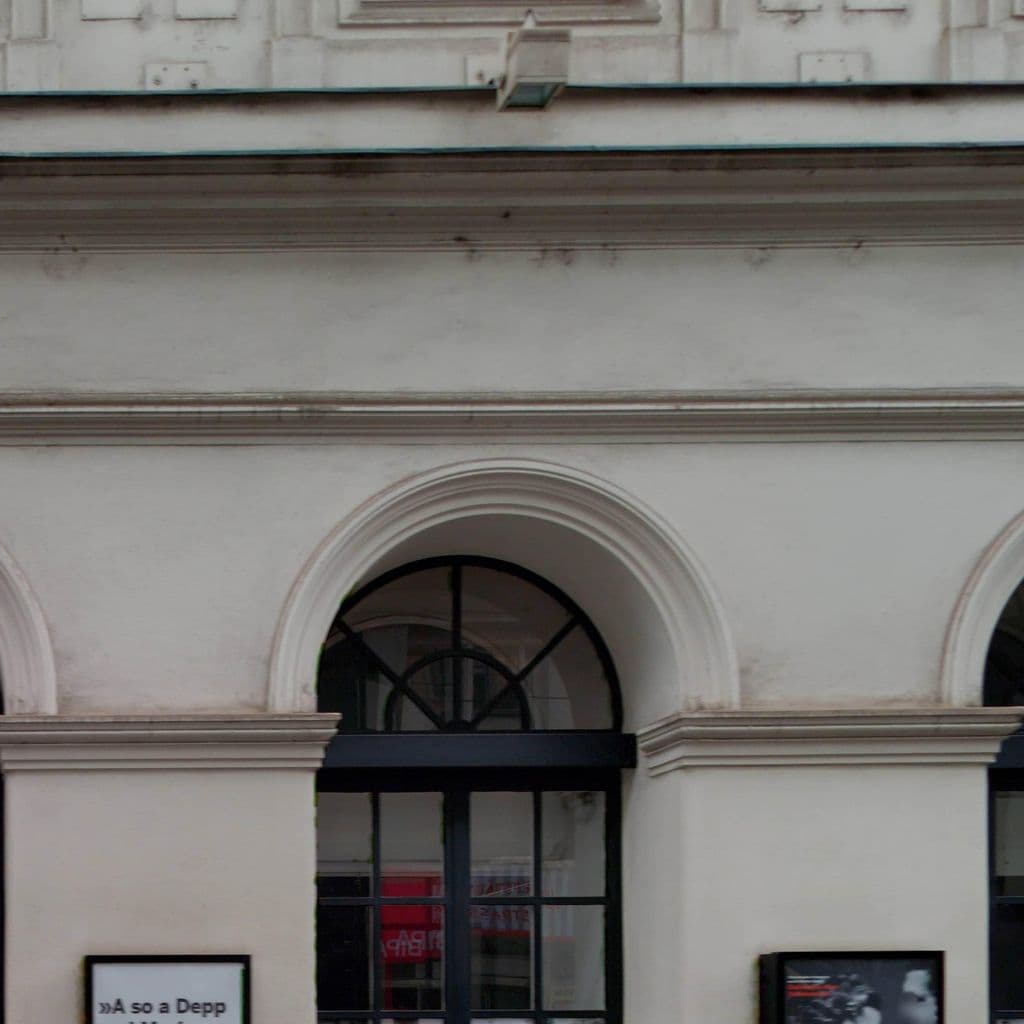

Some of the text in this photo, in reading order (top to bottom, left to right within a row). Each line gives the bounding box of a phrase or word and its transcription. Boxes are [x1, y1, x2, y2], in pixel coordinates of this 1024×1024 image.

[99, 998, 226, 1017] »A so a Depp
